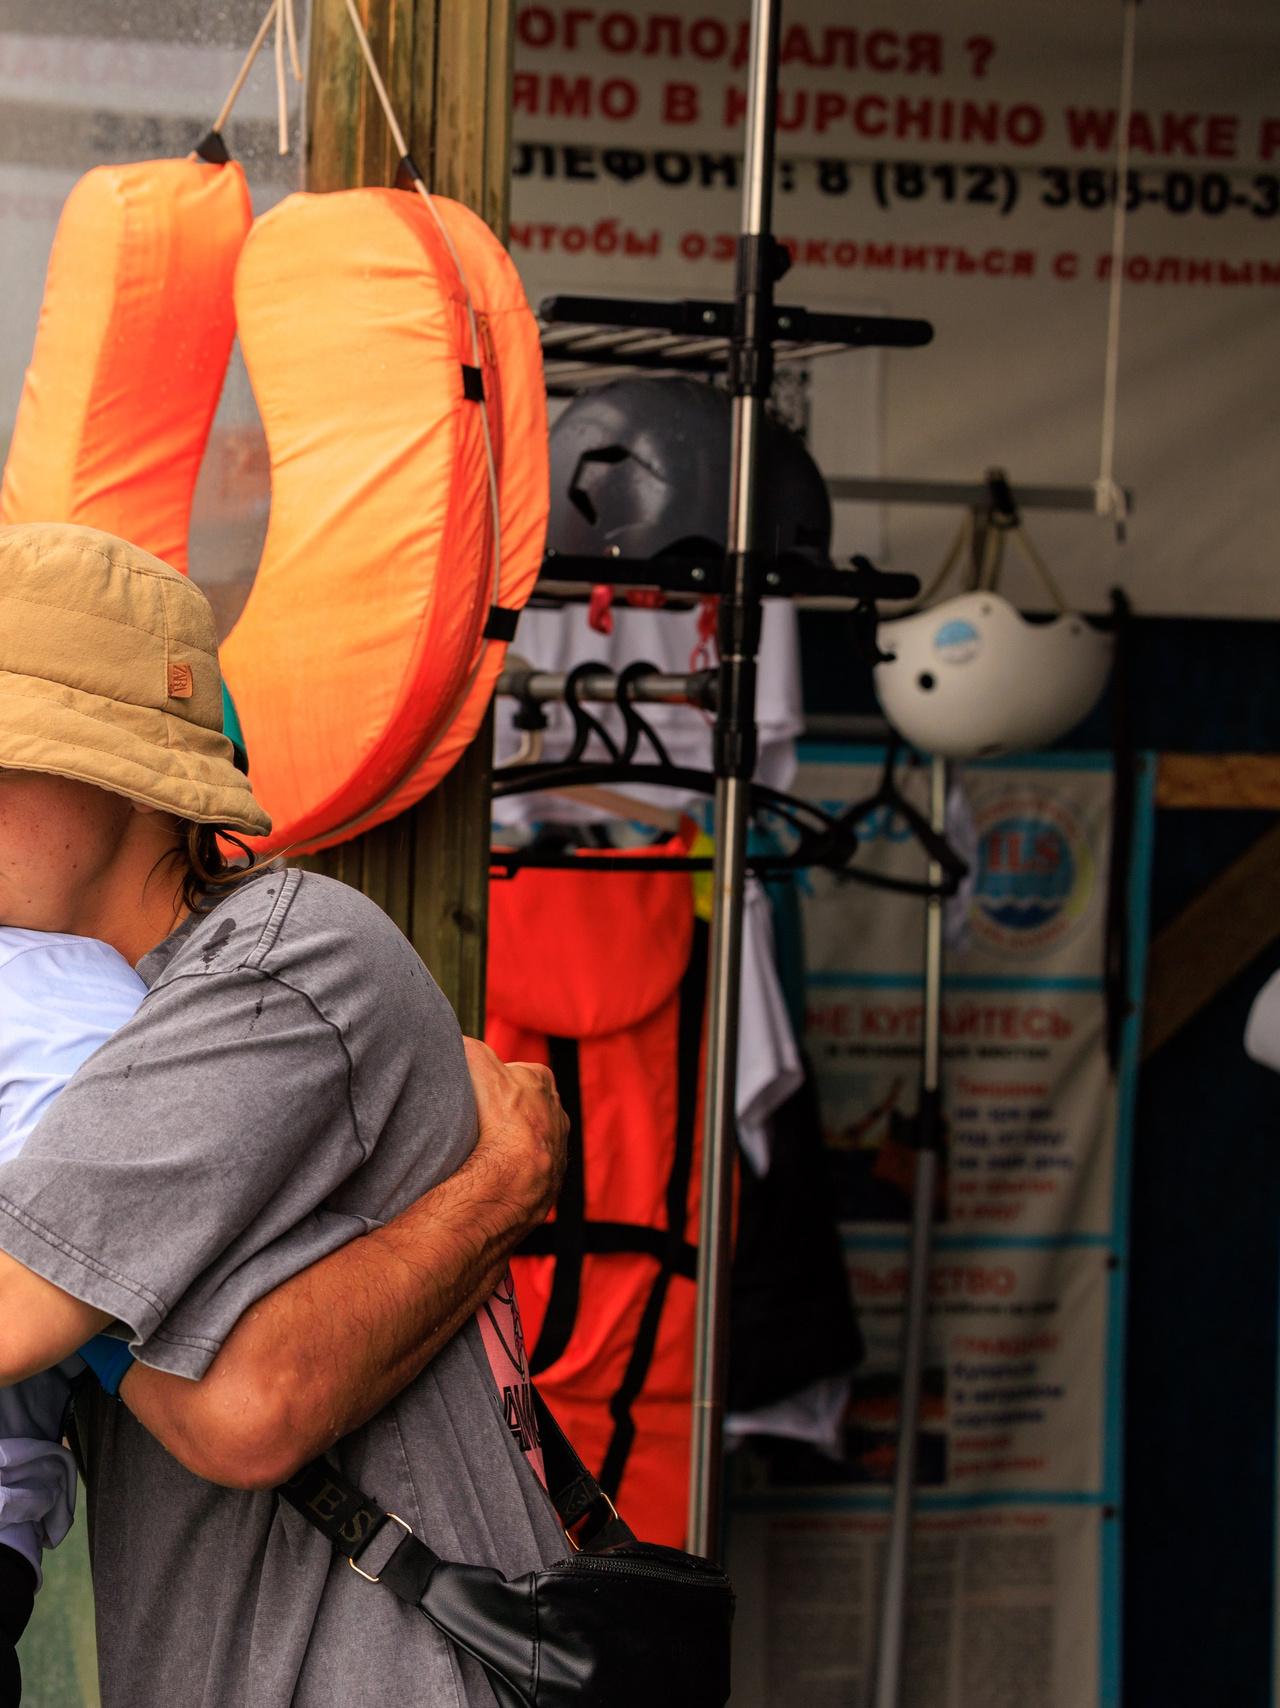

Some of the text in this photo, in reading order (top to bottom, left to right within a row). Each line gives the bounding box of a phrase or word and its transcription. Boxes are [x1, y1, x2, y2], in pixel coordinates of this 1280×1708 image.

[966, 36, 996, 77] ?
[1066, 107, 1239, 158] WAKE
[874, 161, 1018, 215] (812)
[510, 218, 660, 258] чтобы
[680, 236, 1036, 278] озкомиться
[1052, 251, 1079, 280] с
[173, 665, 187, 692] ZARA
